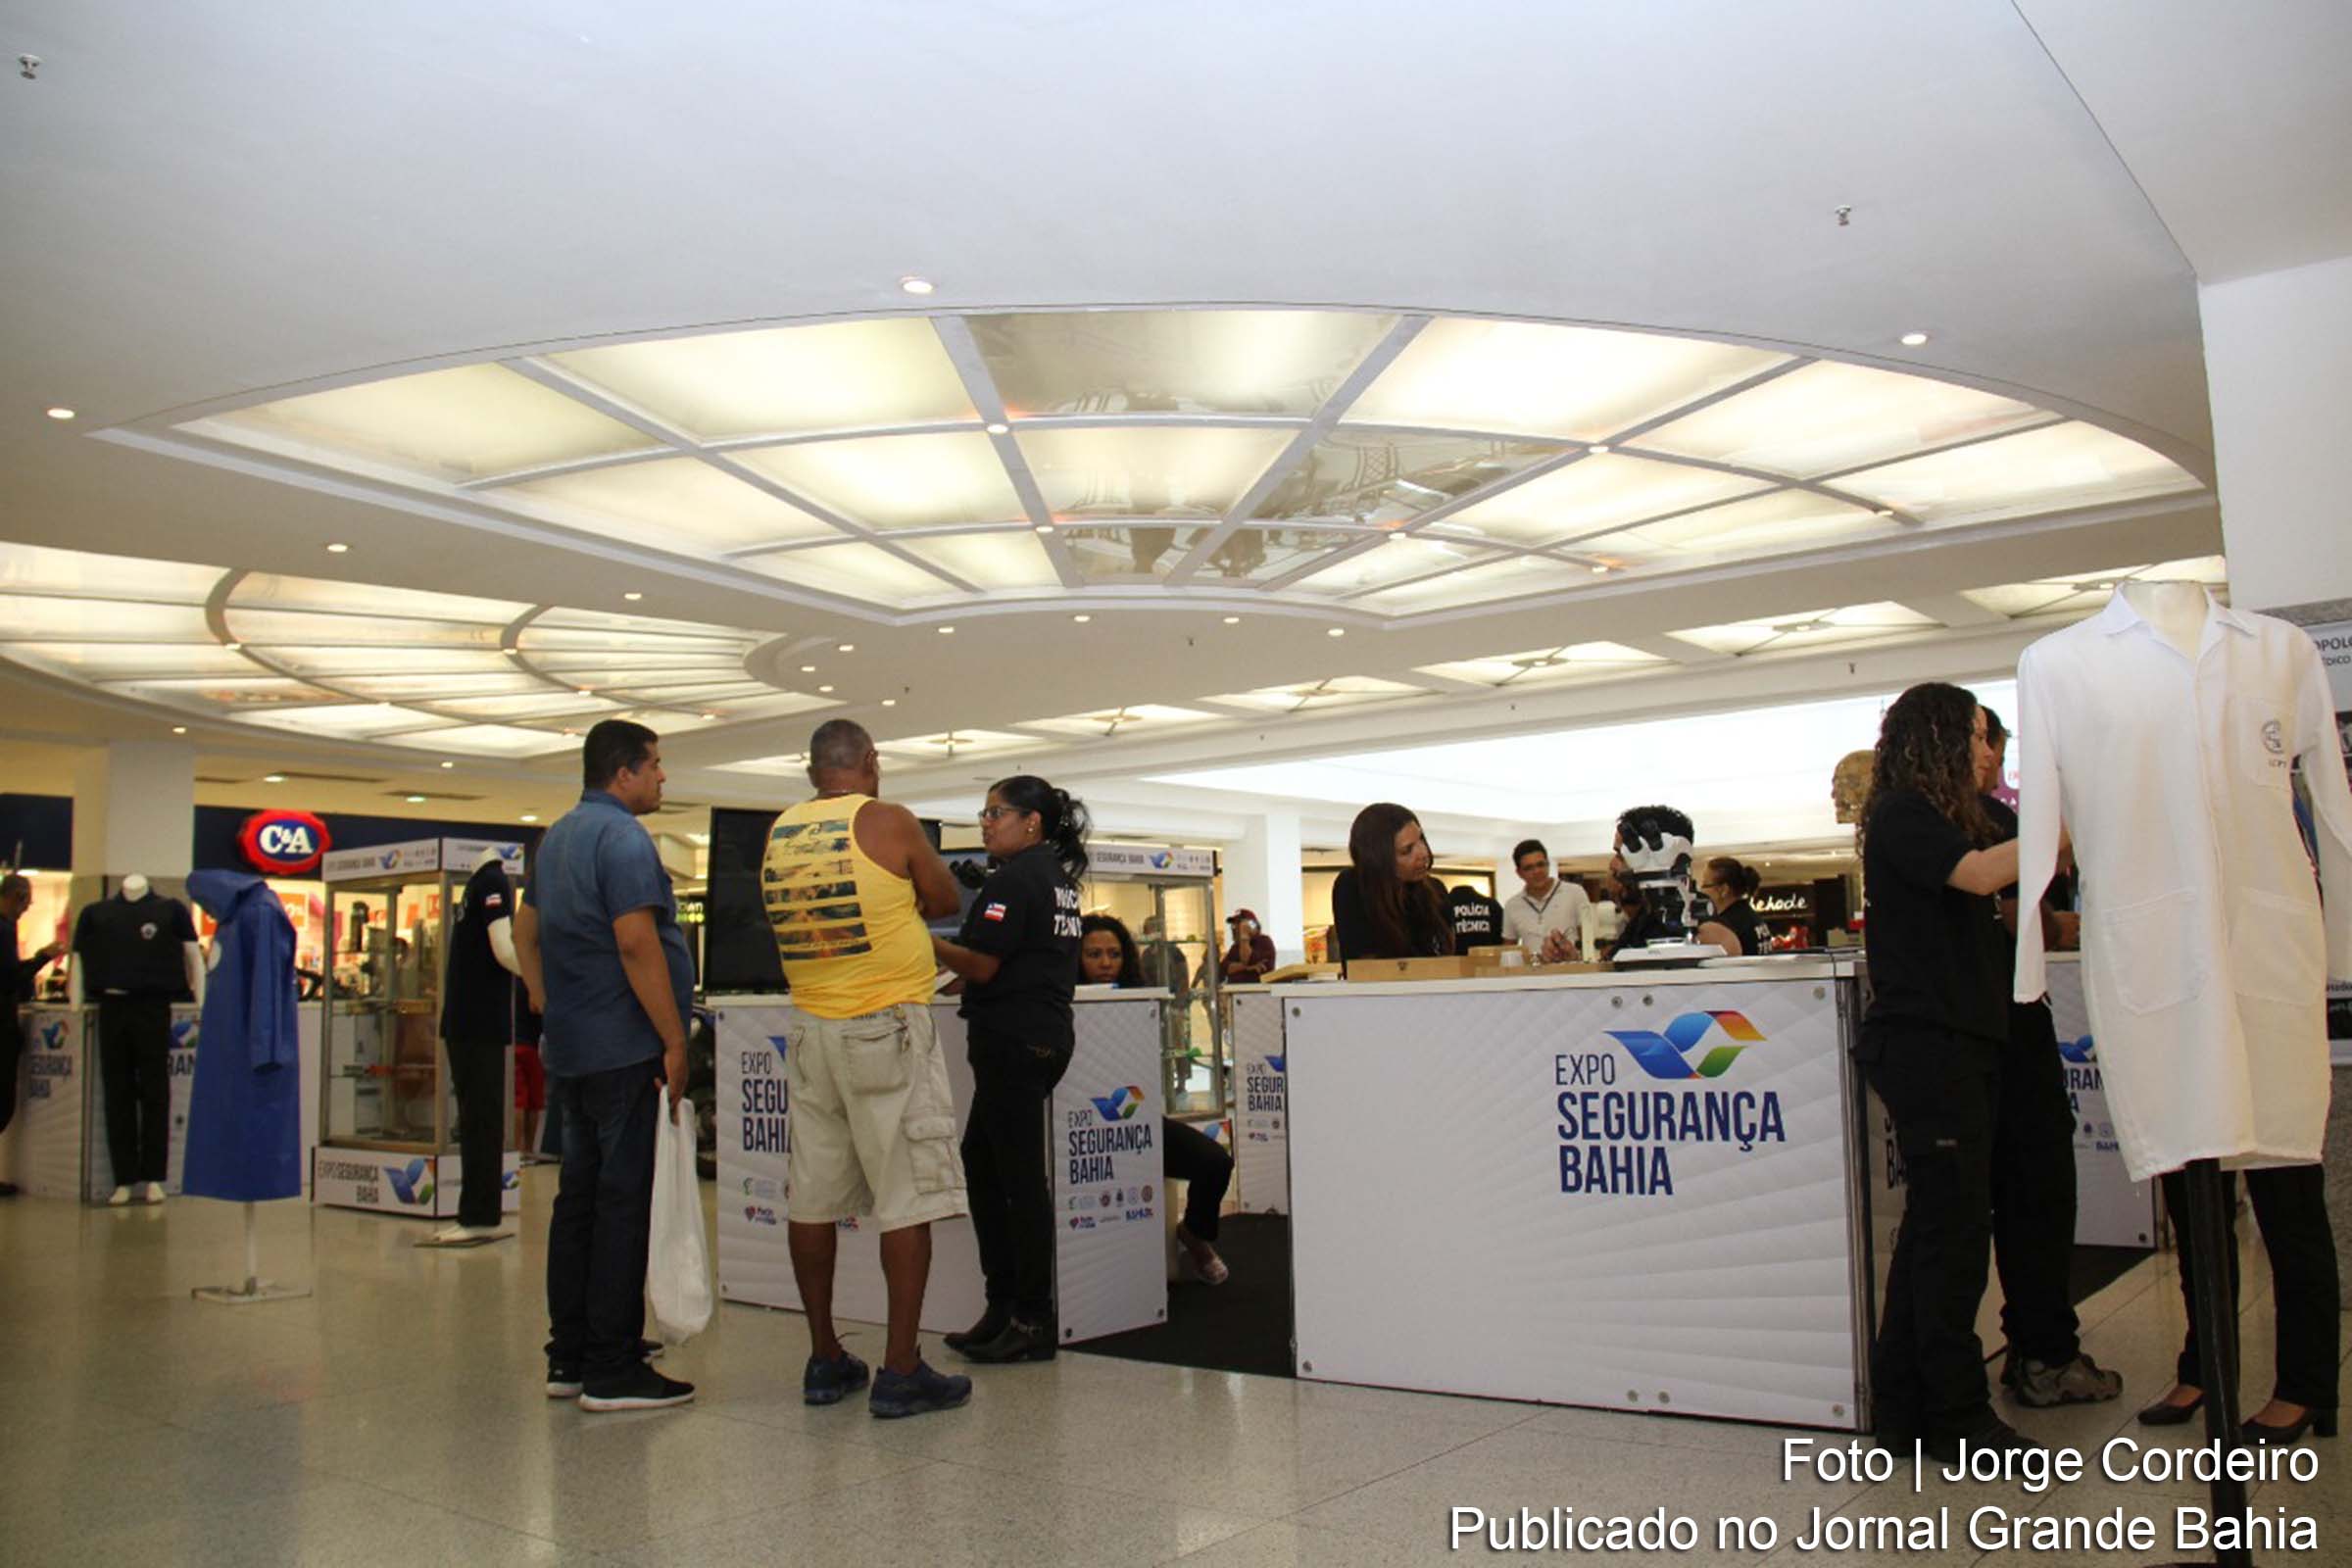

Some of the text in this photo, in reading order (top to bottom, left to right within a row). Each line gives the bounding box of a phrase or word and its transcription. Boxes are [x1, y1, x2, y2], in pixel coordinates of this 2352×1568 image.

[260, 824, 314, 855] C&A
[741, 1052, 772, 1075] EXPO
[1555, 1054, 1615, 1085] EXPO
[1068, 1109, 1094, 1129] EXPO
[1248, 1095, 1284, 1112] BAHIA
[1557, 1091, 1786, 1152] SEGURANÇA
[1069, 1124, 1152, 1156] SEGURANÇA
[1069, 1155, 1114, 1185] BAHIA
[1560, 1145, 1674, 1196] BAHIA
